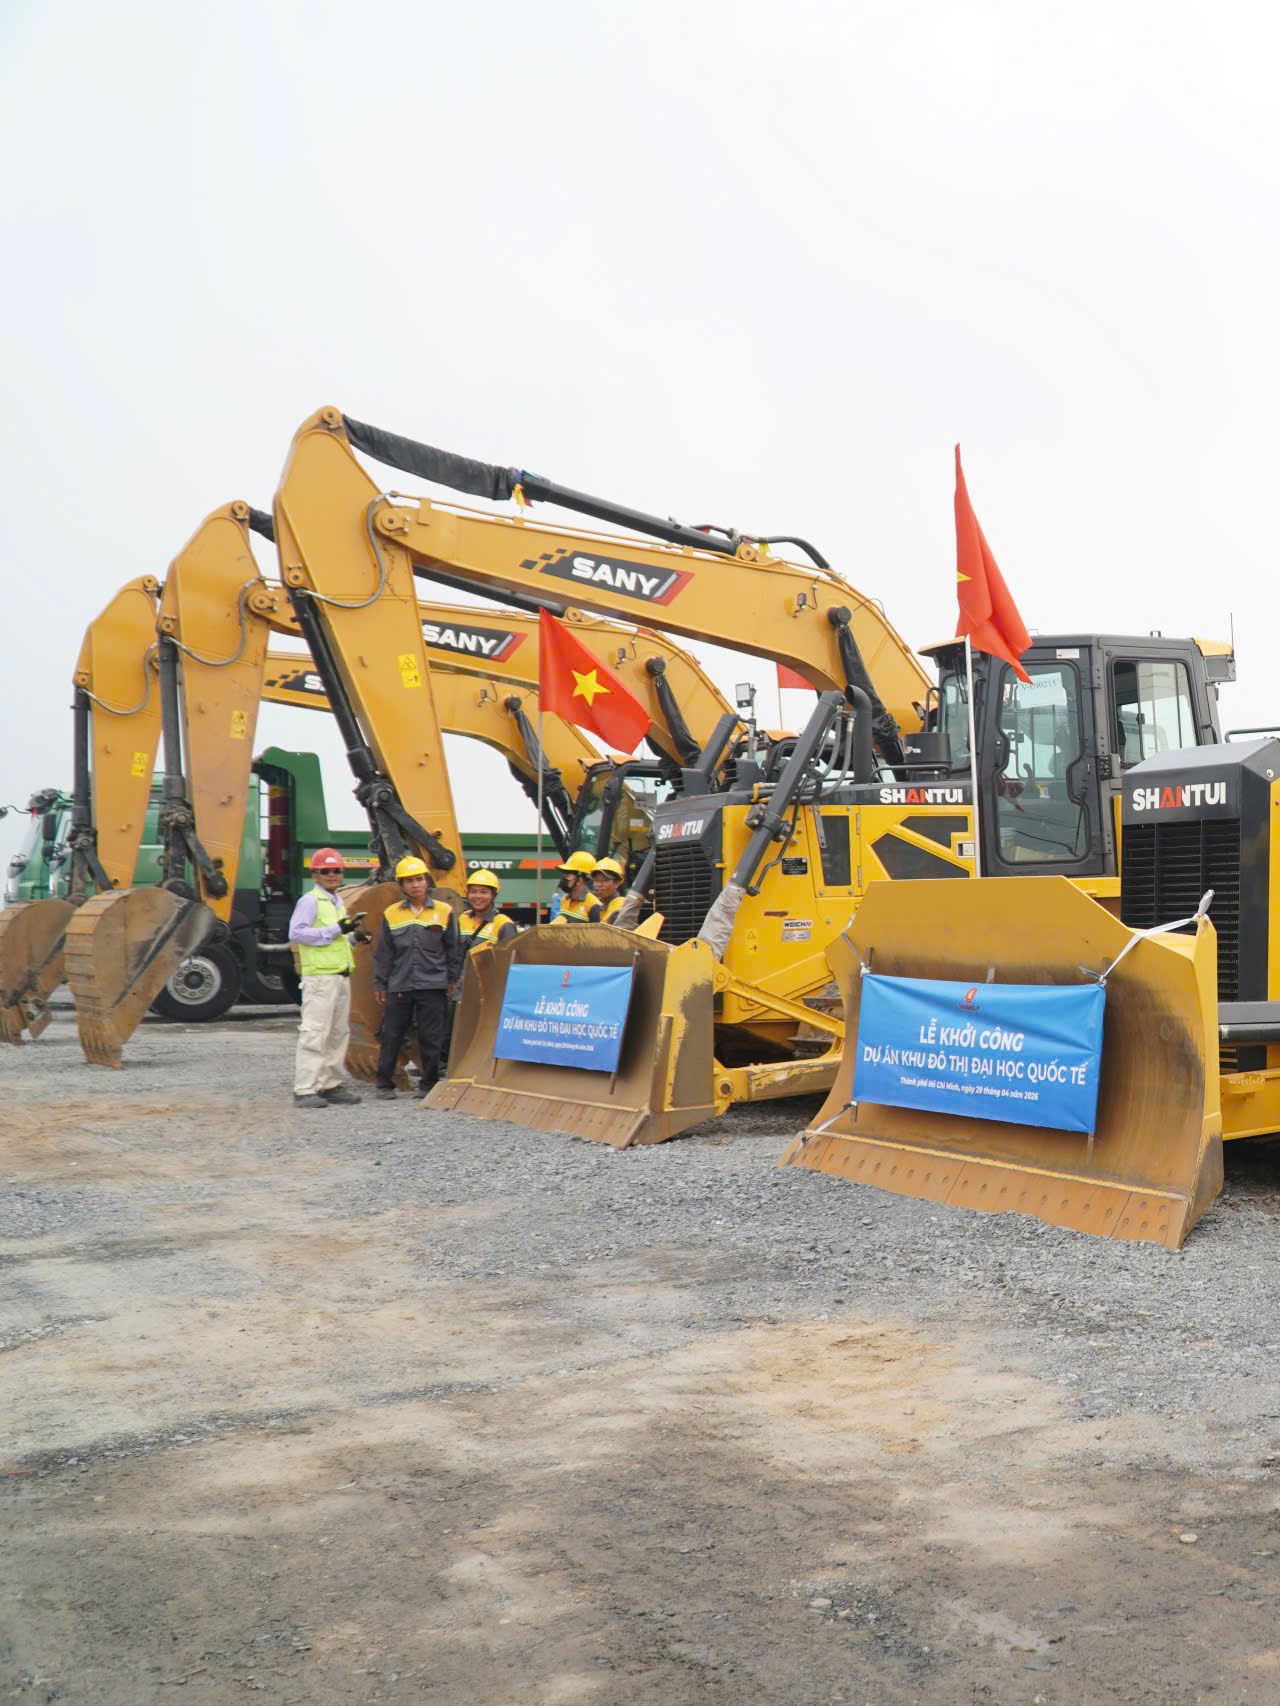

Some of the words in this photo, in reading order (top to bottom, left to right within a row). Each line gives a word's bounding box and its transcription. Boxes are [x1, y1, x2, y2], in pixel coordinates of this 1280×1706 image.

[571, 557, 660, 596] SANY
[422, 624, 498, 655] SANY
[880, 788, 963, 804] SHANTUI
[1132, 782, 1226, 811] SHANTUI
[658, 819, 704, 840] SHANTUI
[919, 1018, 937, 1045] LỄ
[939, 1023, 975, 1049] KHỞI
[979, 1027, 1025, 1052] CÔNG
[863, 1045, 882, 1067] DỰ
[883, 1045, 899, 1065] ÁN
[901, 1049, 926, 1068] KHU
[928, 1051, 947, 1070] ĐÔ
[949, 1055, 969, 1077] THỊ
[971, 1059, 993, 1080] ĐẠI
[996, 1060, 1024, 1082] HỌC
[1027, 1059, 1067, 1083] QUỐC
[1070, 1062, 1088, 1085] TẾ
